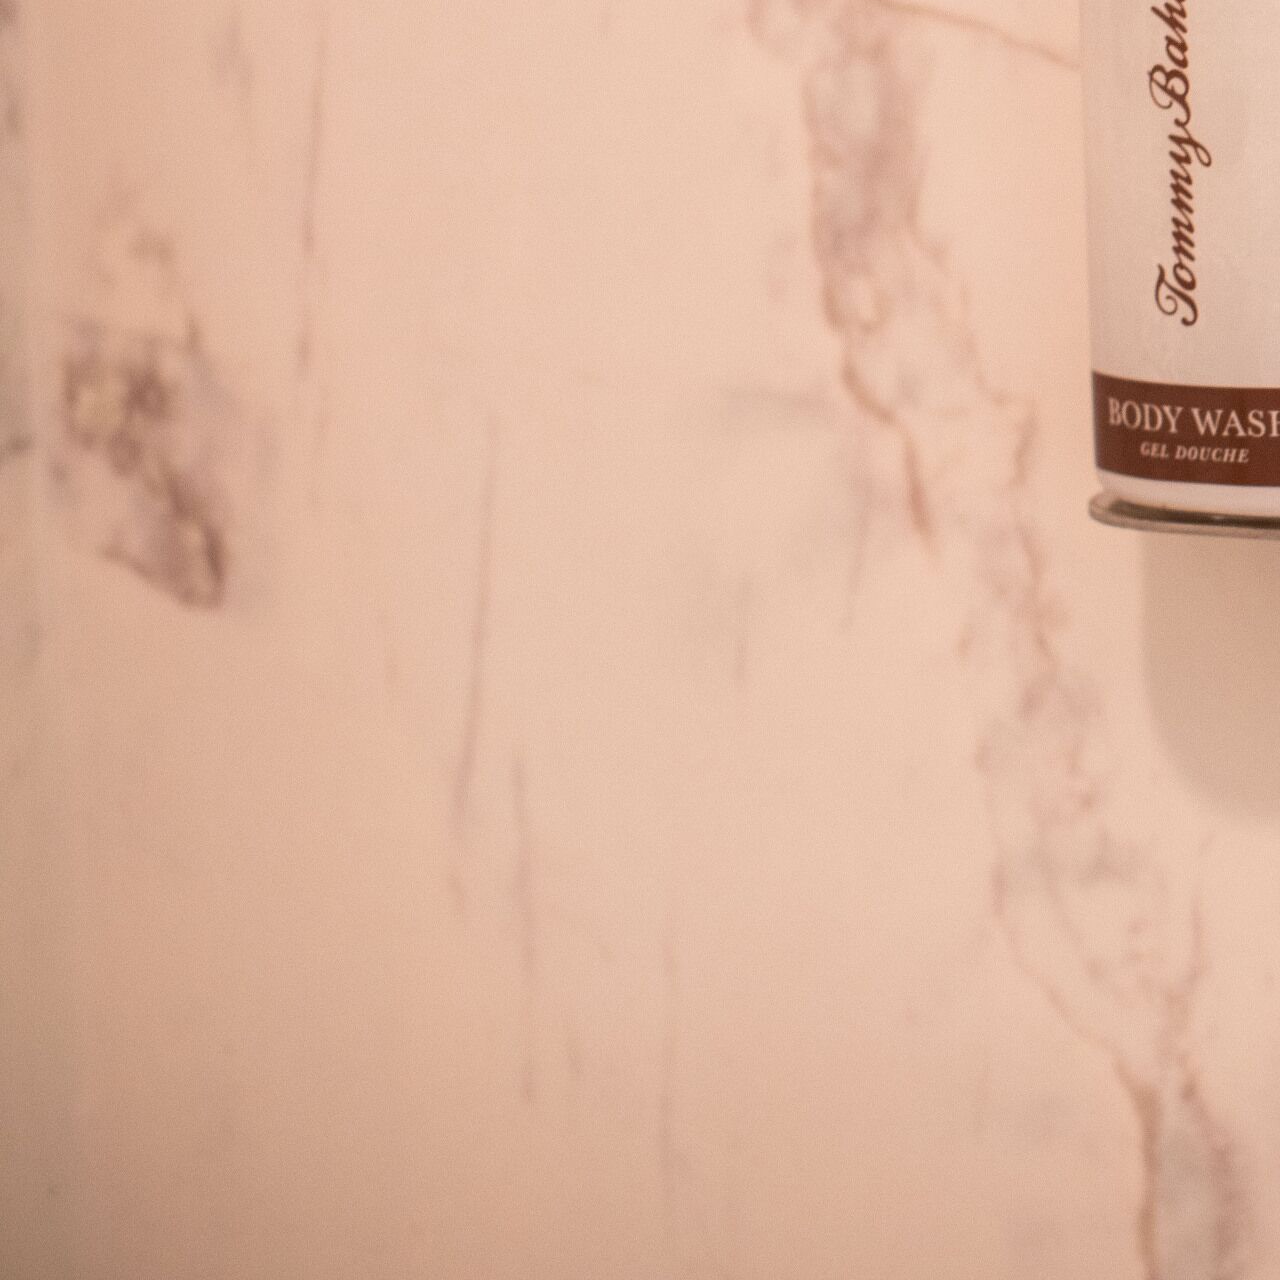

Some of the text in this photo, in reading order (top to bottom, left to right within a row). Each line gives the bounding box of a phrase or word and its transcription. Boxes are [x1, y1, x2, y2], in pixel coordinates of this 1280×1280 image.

[1107, 397, 1183, 434] BODY
[1140, 442, 1250, 463] GEL DOUCHE
